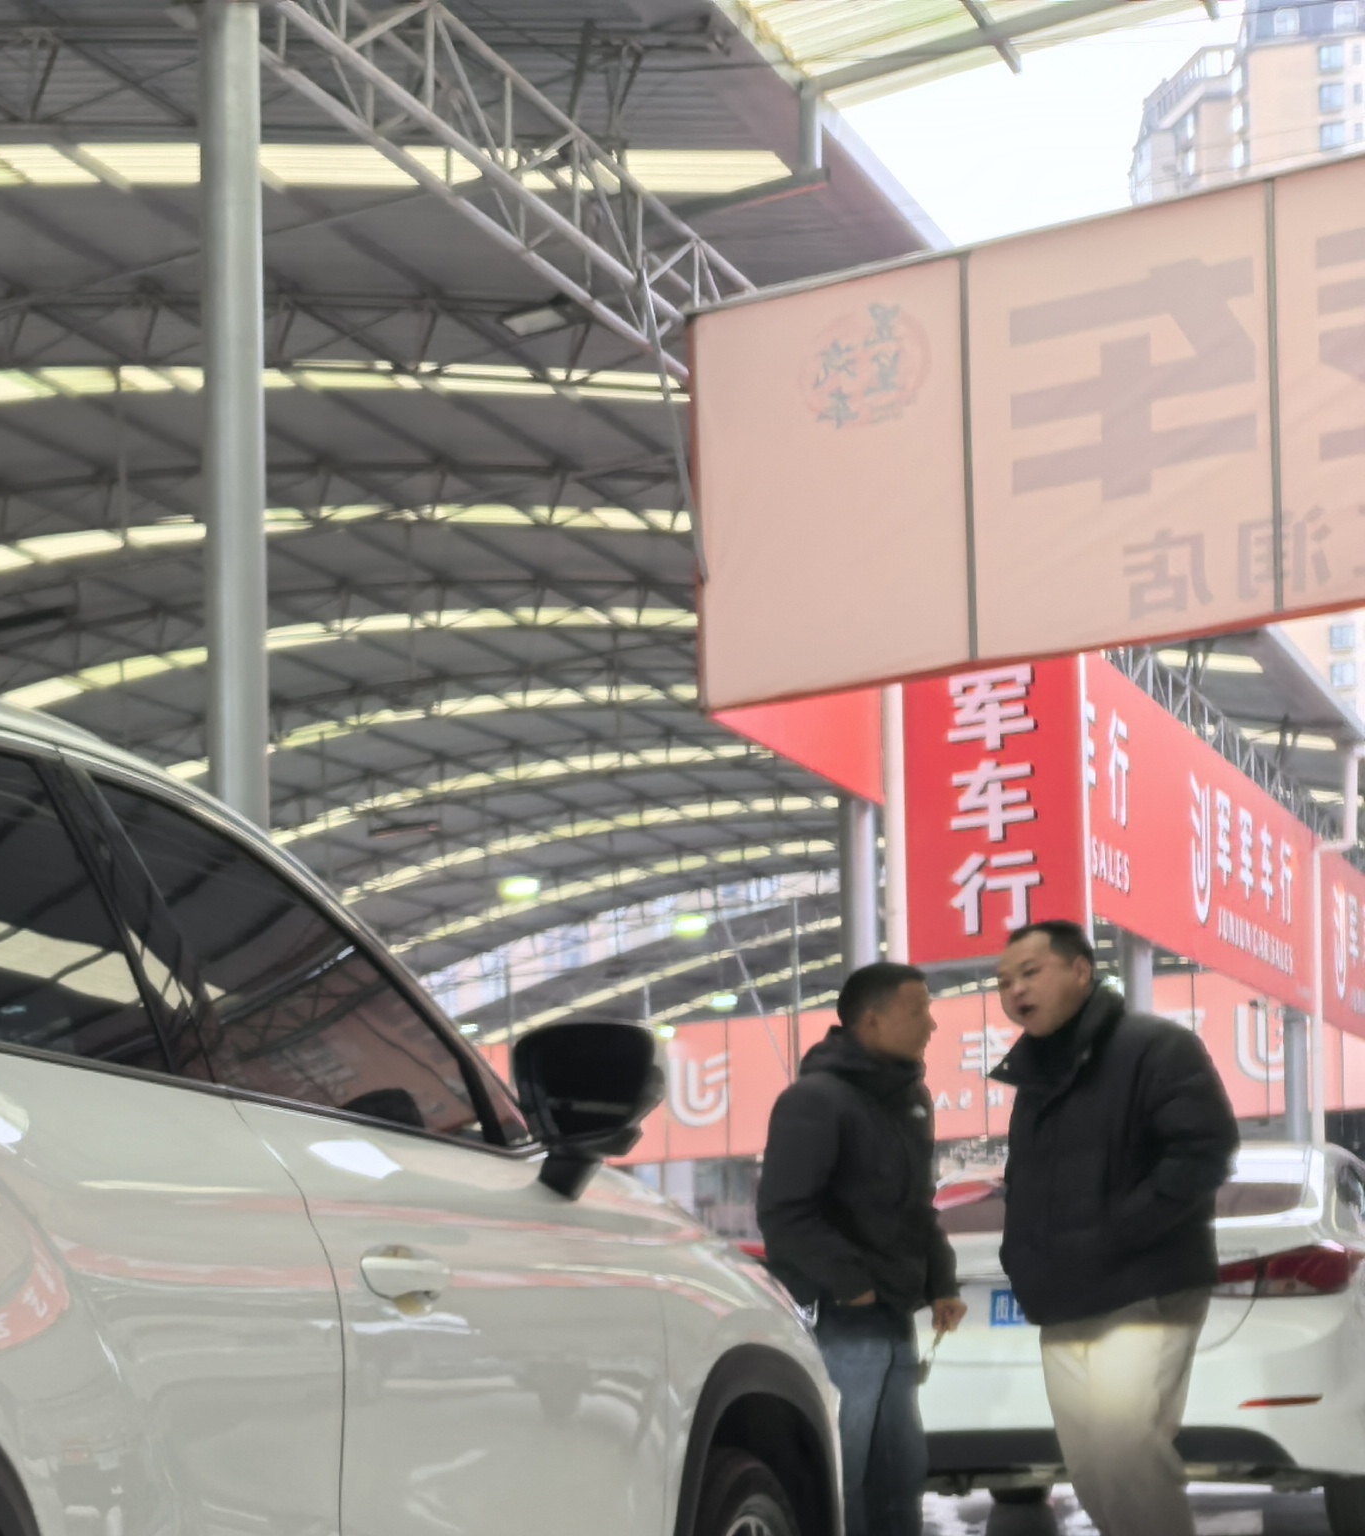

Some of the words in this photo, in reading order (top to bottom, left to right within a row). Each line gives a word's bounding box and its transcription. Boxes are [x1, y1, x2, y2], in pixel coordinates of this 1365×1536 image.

[948, 663, 1043, 936] 军车行
[1091, 836, 1130, 895] SALES
[1216, 789, 1293, 926] 军军车行
